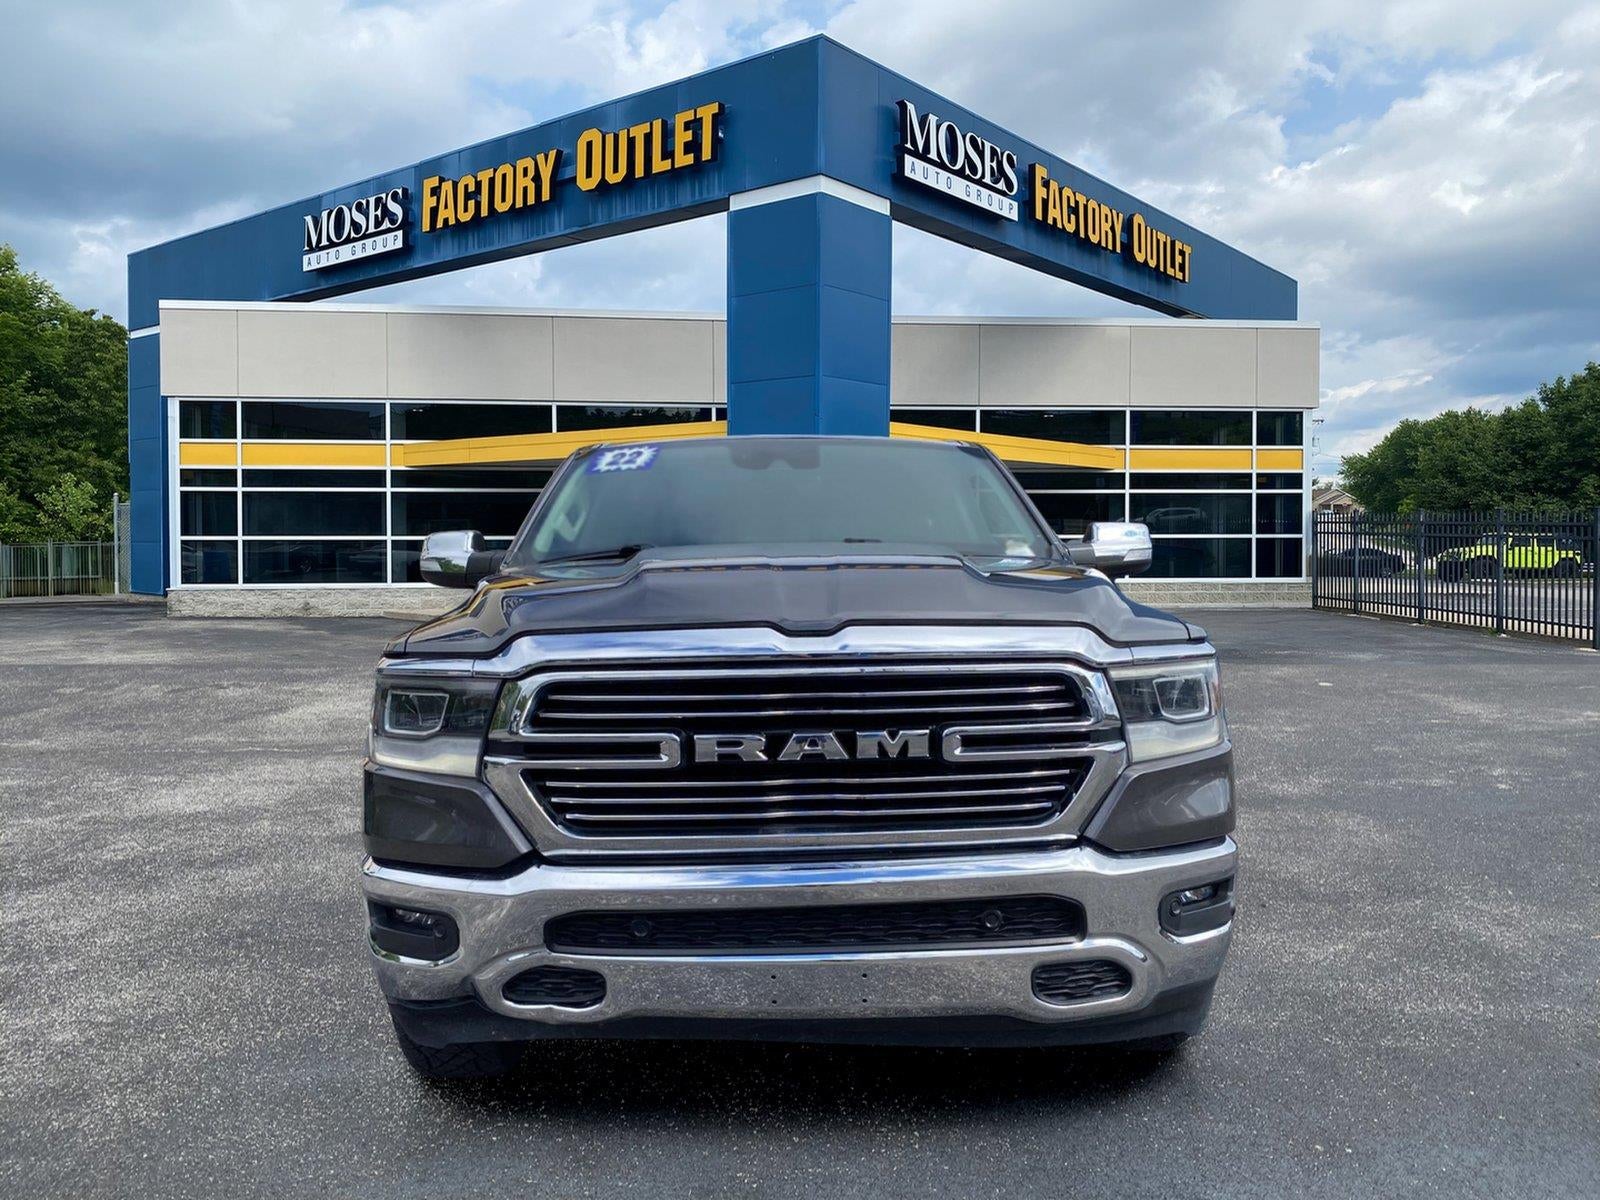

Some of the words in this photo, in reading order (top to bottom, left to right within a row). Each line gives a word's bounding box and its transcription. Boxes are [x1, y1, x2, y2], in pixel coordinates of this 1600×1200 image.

[422, 148, 558, 233] FACTORY
[576, 101, 720, 192] OUTLET
[904, 99, 1018, 195] MOSES
[909, 161, 953, 190] AUTO
[965, 184, 1014, 214] GROUP
[303, 188, 404, 251] MOSES
[1034, 163, 1124, 253] FACTORY
[1131, 213, 1192, 283] OUTLET
[307, 248, 340, 267] AUTO
[350, 234, 399, 256] GROUP
[605, 450, 643, 466] 22
[694, 729, 930, 762] RAM
